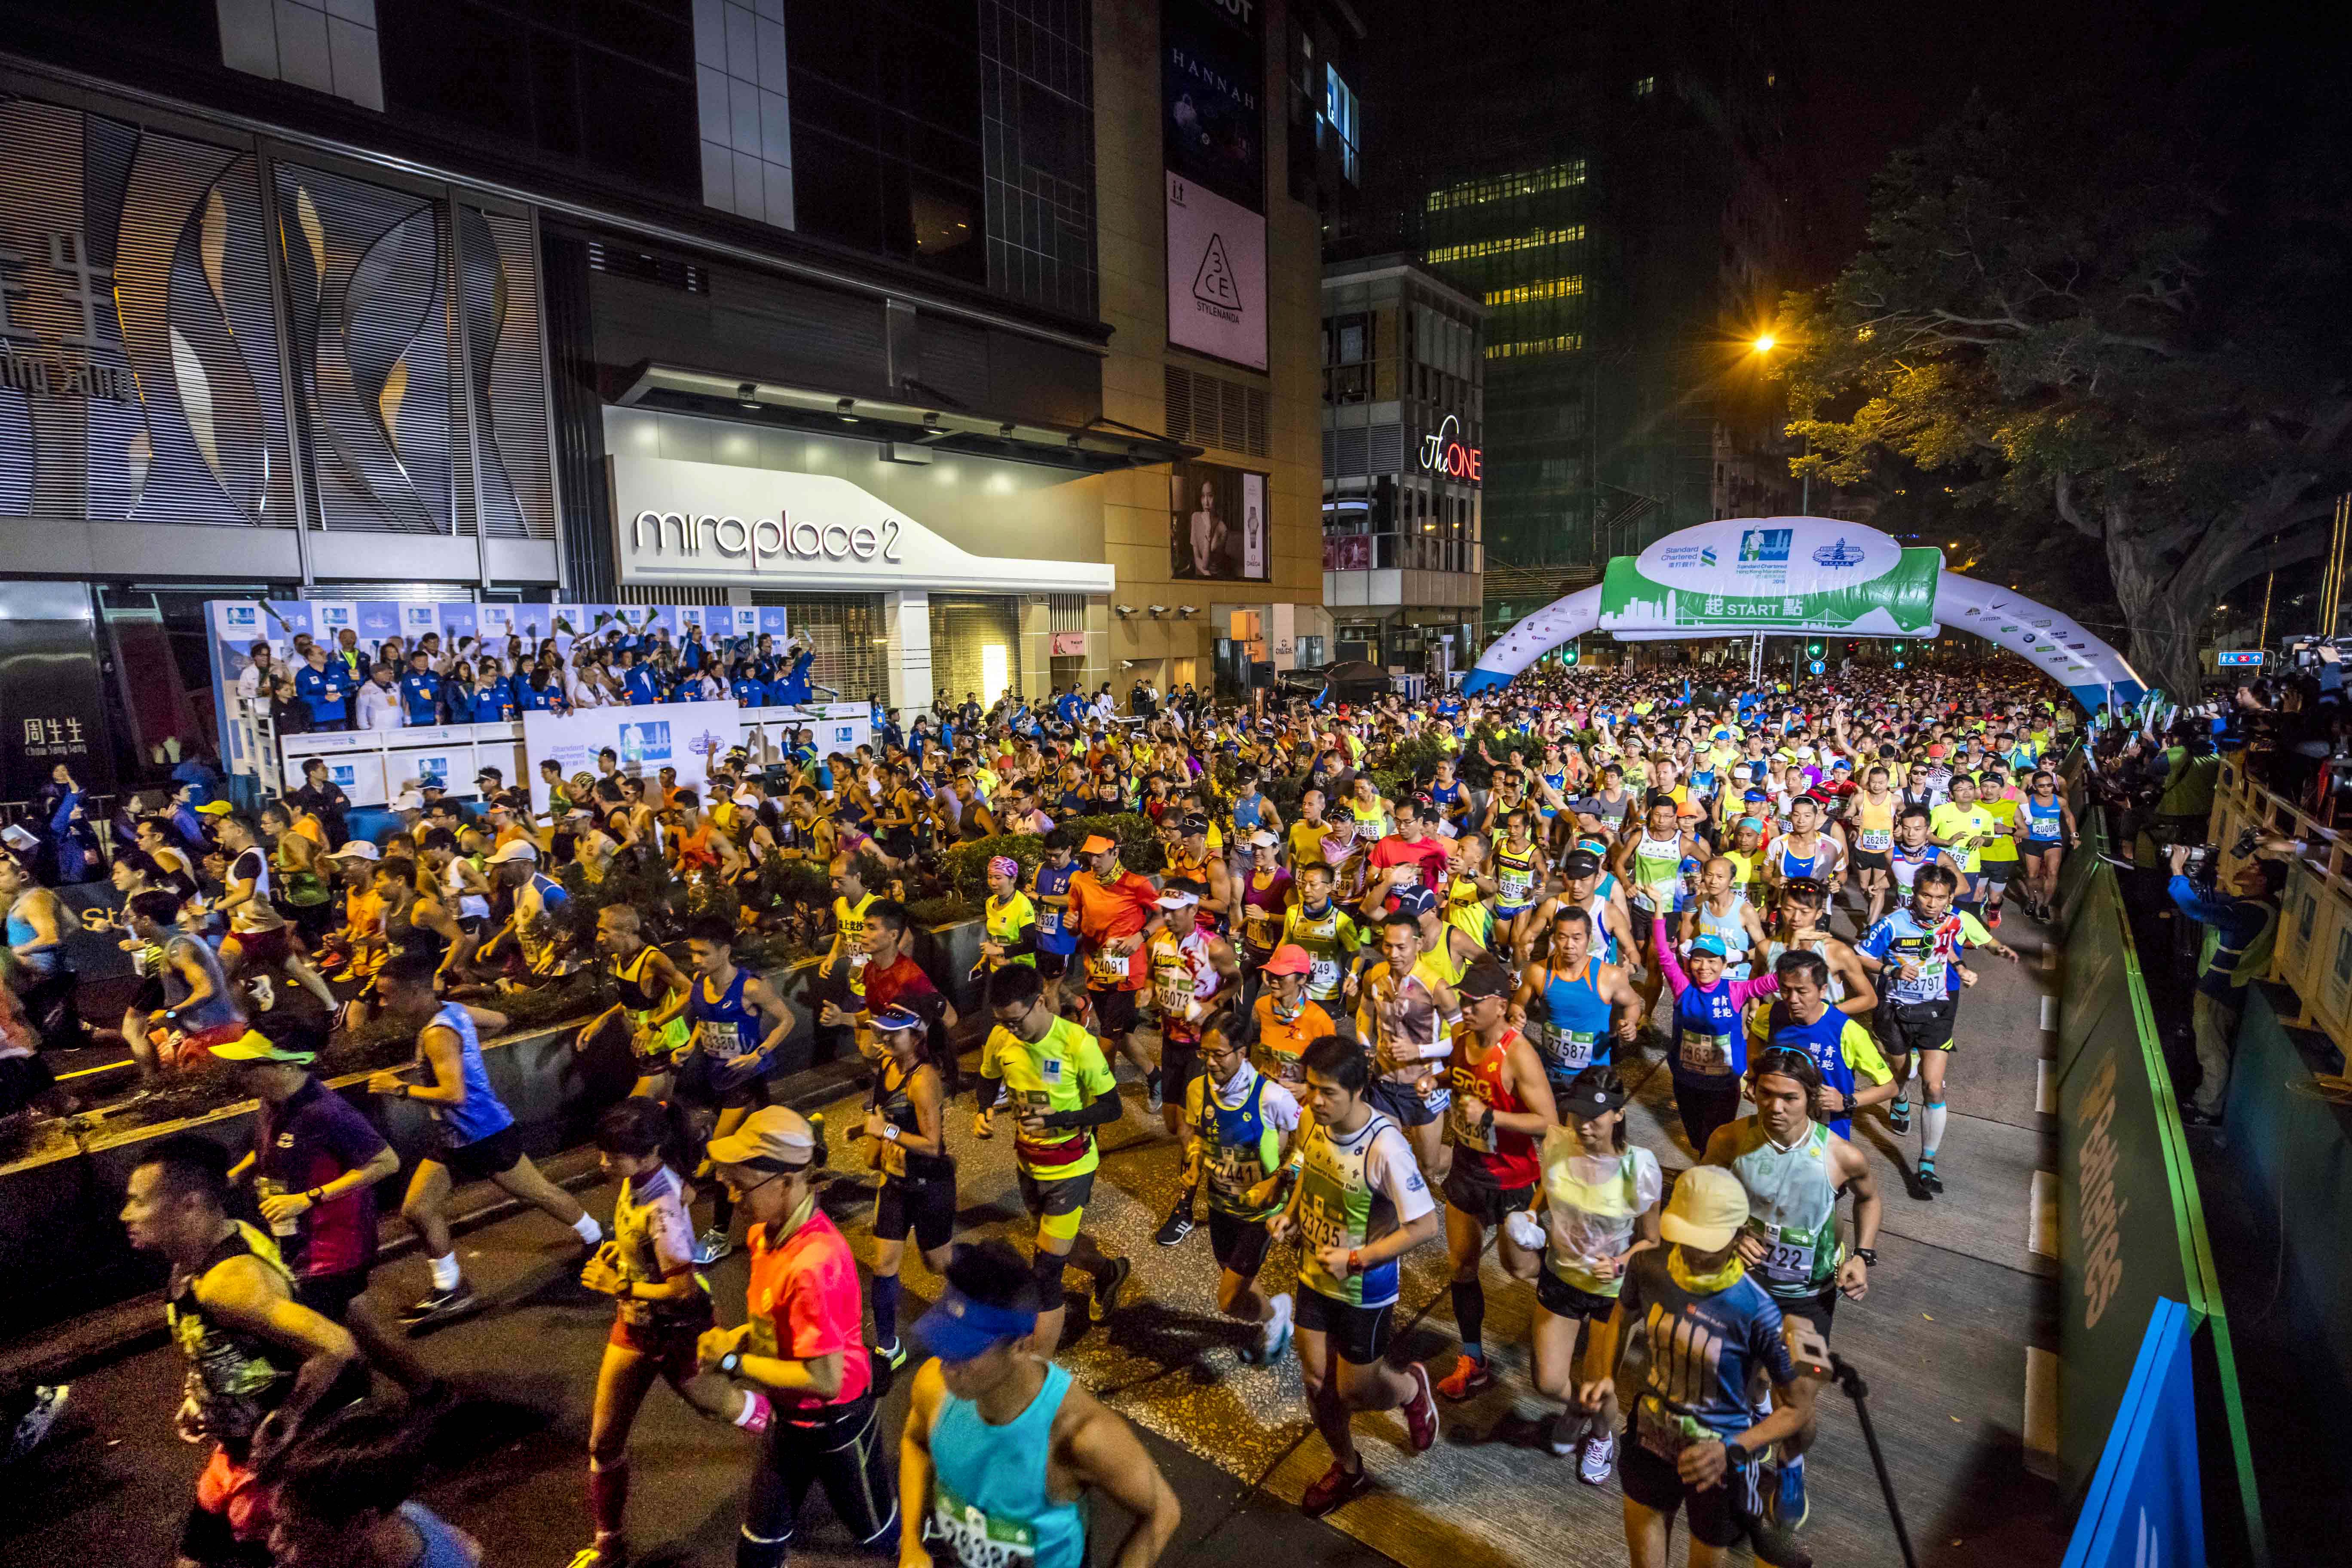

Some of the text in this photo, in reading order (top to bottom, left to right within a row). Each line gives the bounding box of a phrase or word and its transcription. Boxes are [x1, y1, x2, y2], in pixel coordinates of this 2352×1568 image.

[1173, 47, 1255, 110] HANNAH
[1197, 301, 1240, 325] STYLENANDA
[1420, 414, 1482, 482] The ONE
[636, 510, 903, 569] miraplace 2
[1666, 545, 1699, 554] Standard
[1705, 598, 1803, 616] 起 START 點
[24, 717, 85, 745] 周生生
[550, 751, 585, 760] Chartered
[551, 744, 584, 752] Standard
[1358, 827, 1377, 835] 26165
[1867, 836, 1888, 845] 26265
[1502, 880, 1525, 894] 26752
[1901, 939, 1921, 947] ANDY
[1094, 959, 1124, 975] 24091
[1903, 976, 1941, 992] 23797
[1159, 988, 1189, 1008] 26073
[1548, 1036, 1586, 1060] 27587
[2079, 1094, 2123, 1331] Batteries
[1303, 1209, 1340, 1247] 23735
